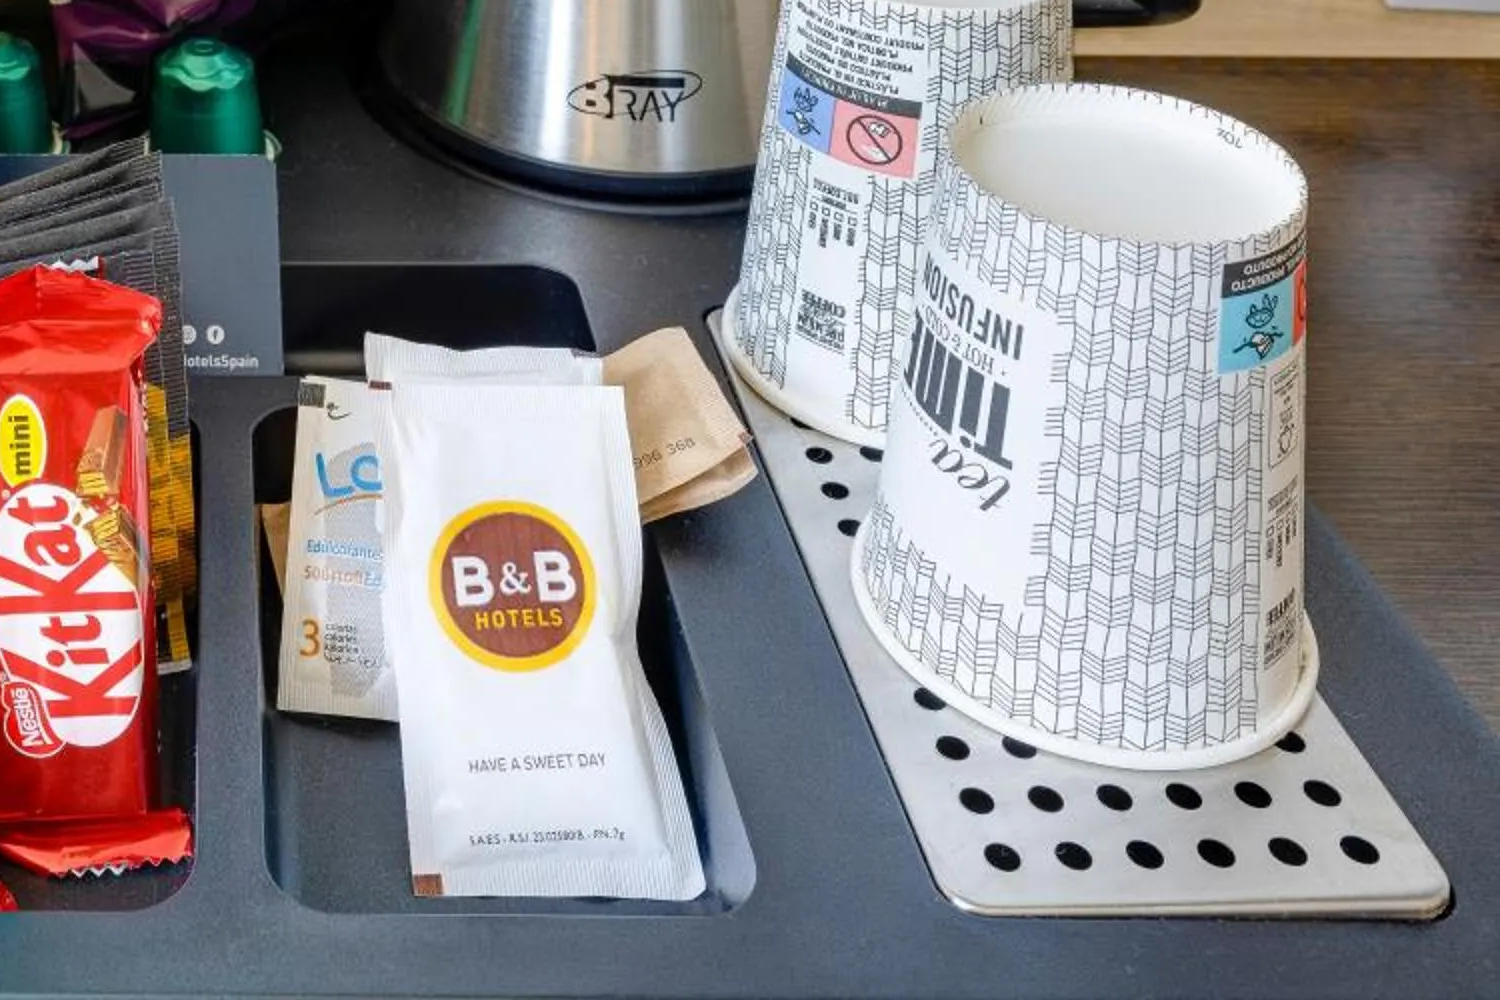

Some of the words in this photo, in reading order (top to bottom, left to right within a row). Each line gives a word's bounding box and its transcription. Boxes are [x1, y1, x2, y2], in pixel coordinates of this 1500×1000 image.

[923, 250, 1025, 361] INFUSION
[963, 341, 995, 376] HOT
[7, 414, 31, 477] mini
[929, 438, 1011, 512] tea
[451, 550, 577, 608] B&B
[299, 618, 321, 658] 3
[475, 607, 564, 631] HOTELS
[468, 757, 507, 773] HAVE
[511, 756, 521, 771] A
[523, 753, 574, 771] SWEET
[577, 752, 607, 767] DAY
